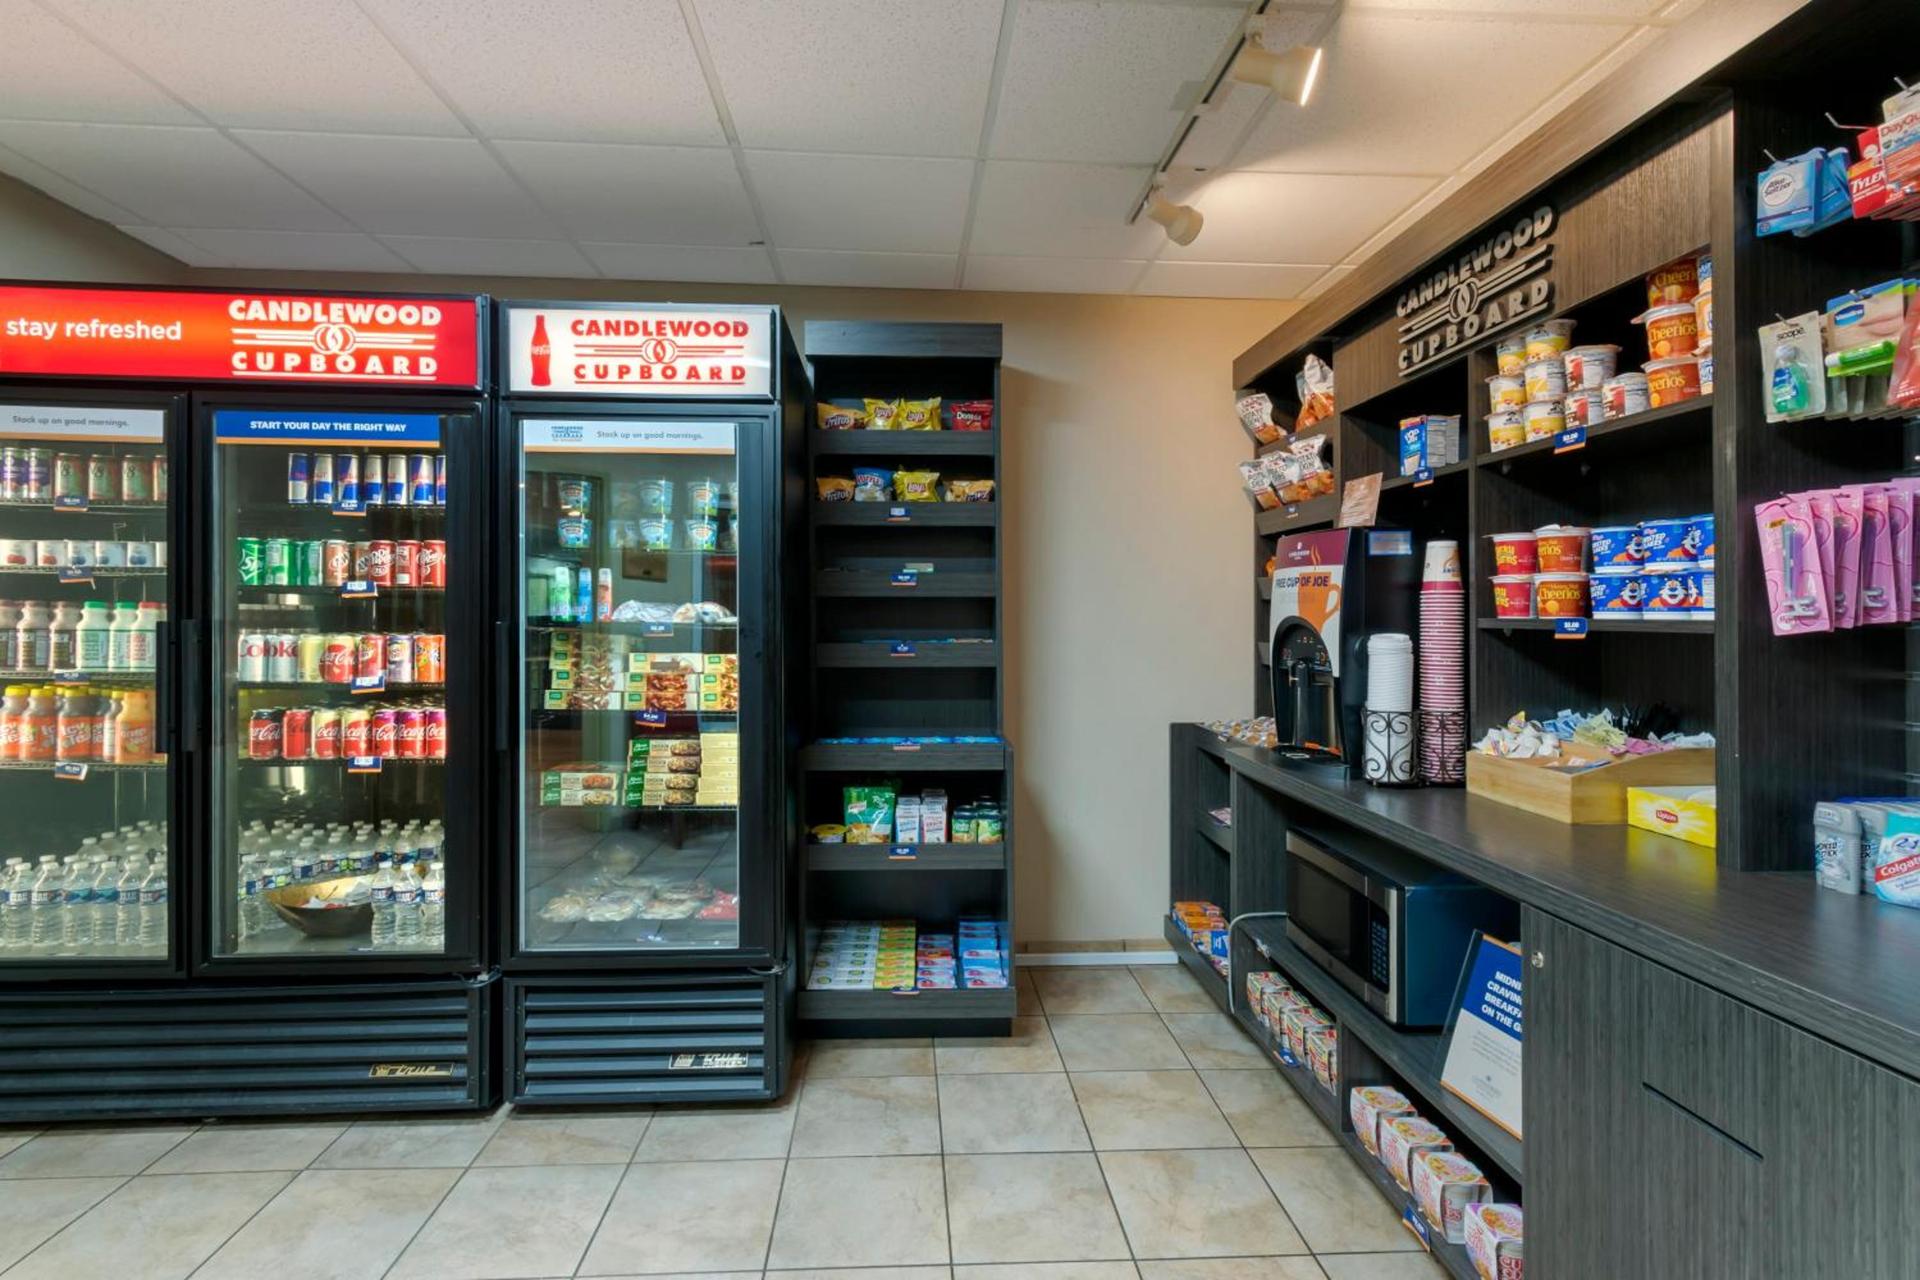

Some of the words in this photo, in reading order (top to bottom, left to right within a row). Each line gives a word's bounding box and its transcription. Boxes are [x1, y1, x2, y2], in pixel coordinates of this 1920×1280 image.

[1396, 206, 1553, 318] CANDLEWOOD
[228, 300, 442, 326] CANDLEWOOD
[1398, 278, 1549, 370] CUPBOARD
[6, 317, 57, 340] stay
[65, 318, 182, 340] refreshed
[571, 319, 749, 338] CANDLEWOOD
[231, 351, 438, 375] CUPBOARD
[574, 364, 746, 381] CUPBOARD
[250, 421, 281, 430] START
[282, 421, 309, 431] YOUR
[311, 423, 331, 432] DAY
[332, 423, 352, 432] THE
[354, 424, 383, 432] RIGHT
[385, 424, 407, 433] WAY
[1313, 575, 1330, 587] JOE
[1482, 1004, 1495, 1018] ON
[1496, 1010, 1512, 1028] THE
